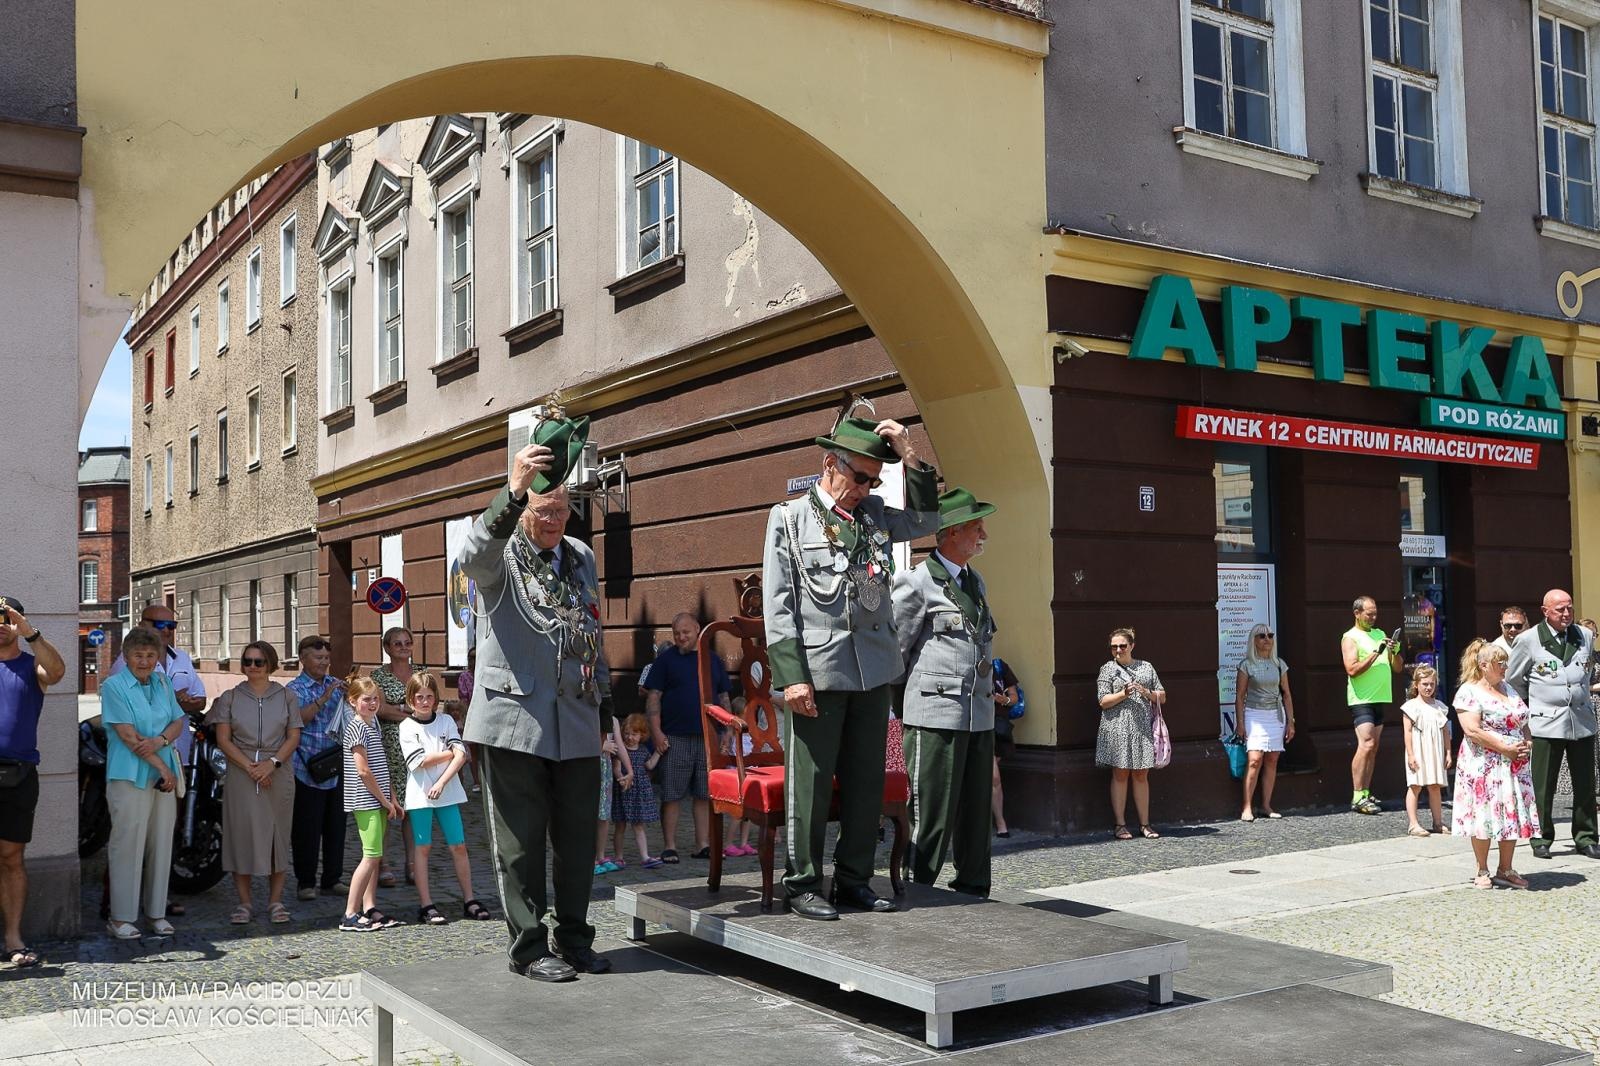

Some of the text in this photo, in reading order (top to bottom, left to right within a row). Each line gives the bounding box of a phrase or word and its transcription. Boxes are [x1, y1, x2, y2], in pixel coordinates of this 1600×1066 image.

[1128, 274, 1562, 409] APTEKA
[1195, 413, 1263, 438] RYNEK
[1268, 421, 1289, 441] 12
[1305, 425, 1390, 450] CENTRUM
[1394, 434, 1534, 464] FARMACEUTYCZNE
[1438, 405, 1558, 434] POD RÓŻAMI
[1142, 495, 1152, 505] 12
